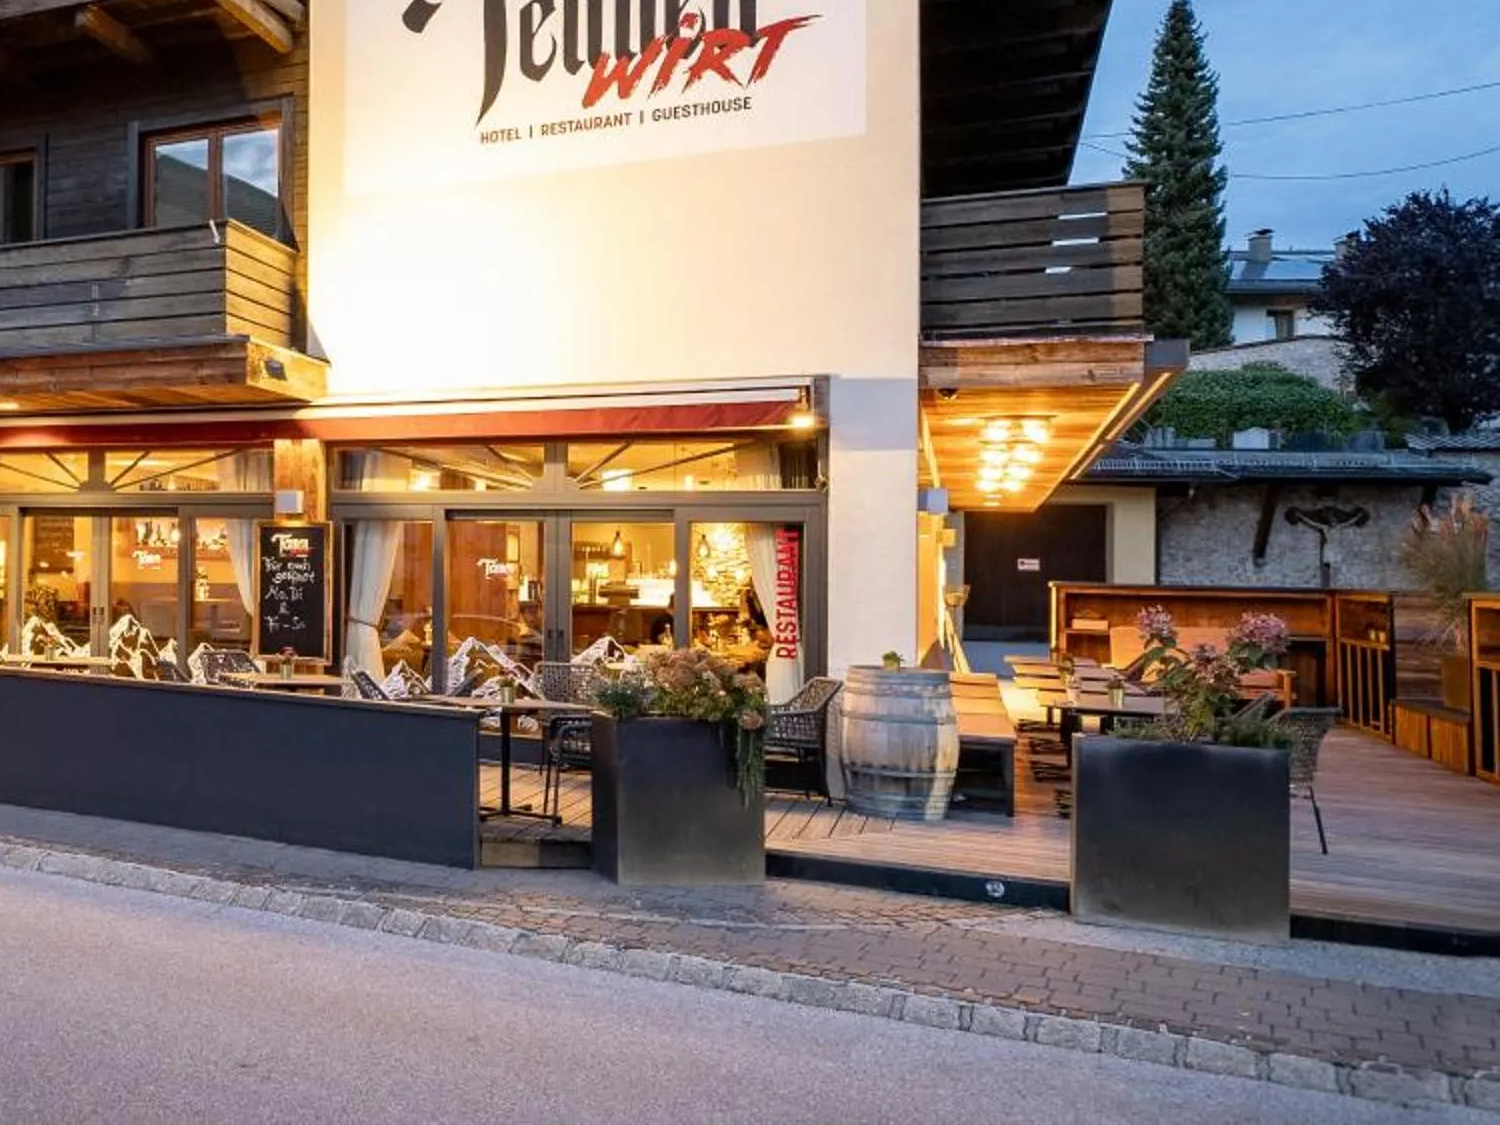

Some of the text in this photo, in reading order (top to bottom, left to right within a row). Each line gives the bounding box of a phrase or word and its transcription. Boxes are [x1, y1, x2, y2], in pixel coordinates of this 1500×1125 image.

[480, 128, 521, 144] HOTEL
[541, 112, 632, 137] RESTAURANT
[652, 96, 752, 122] GUESTHOUSE
[776, 529, 799, 660] RESTAURANT
